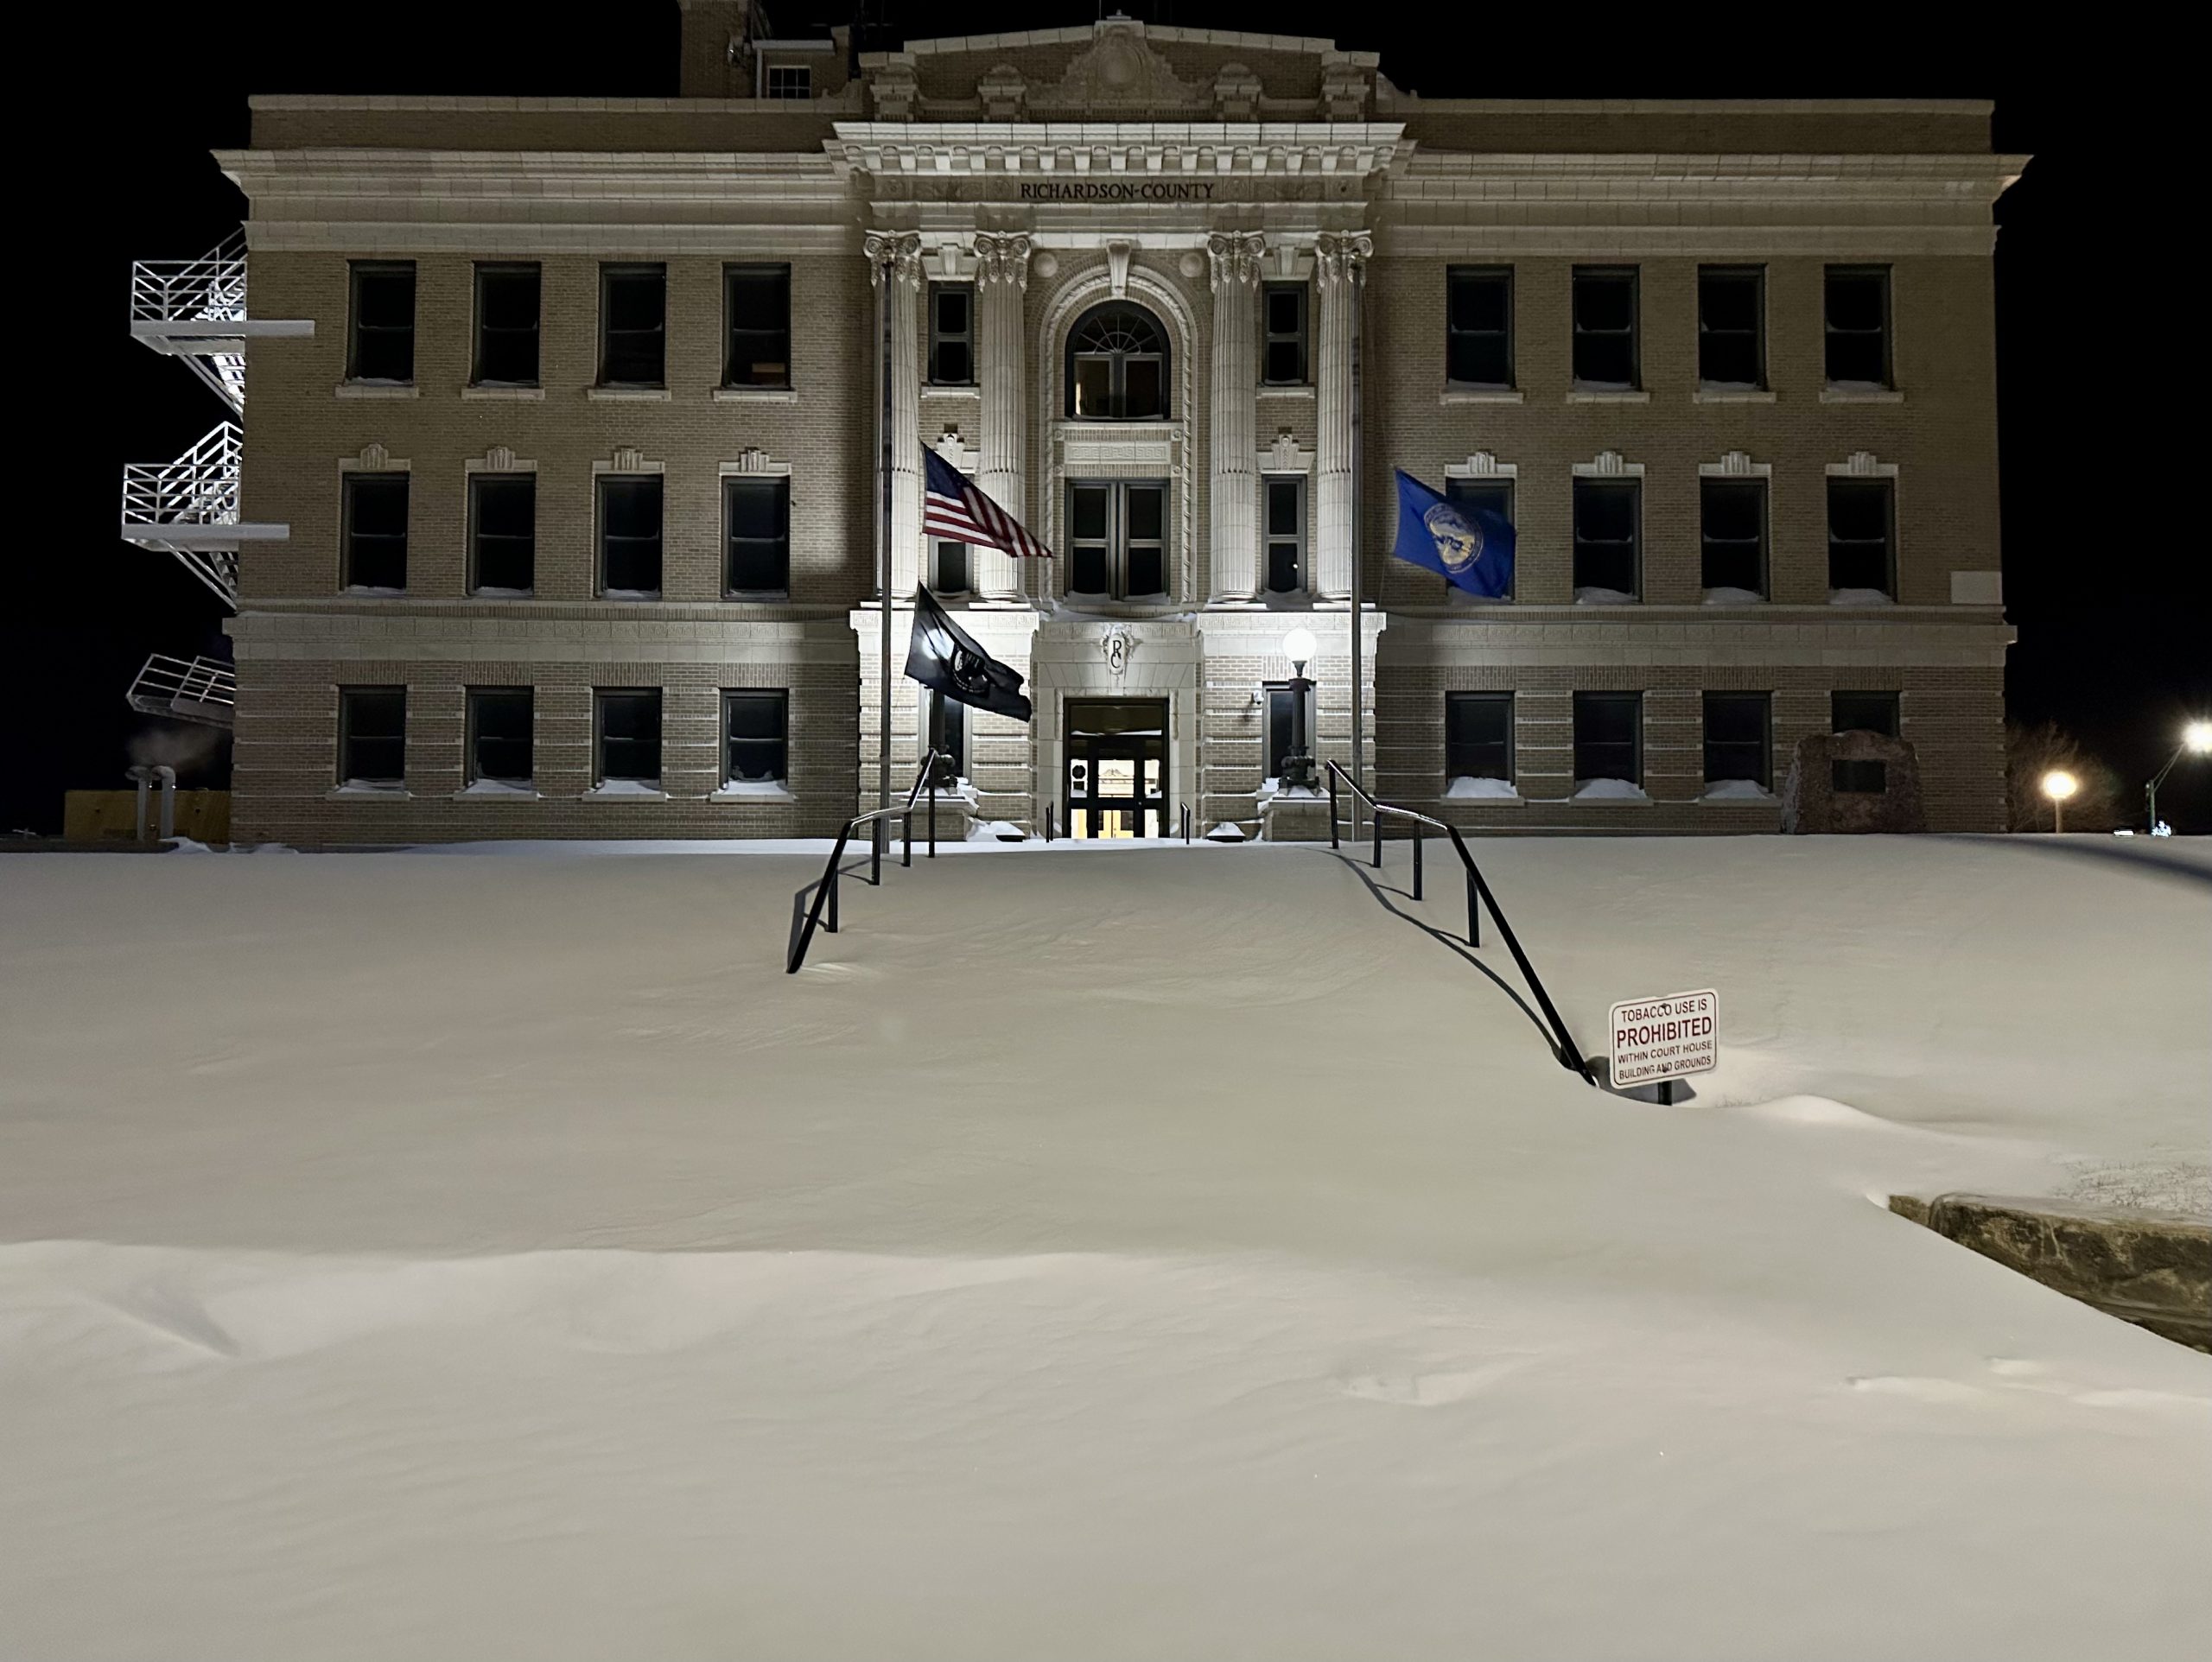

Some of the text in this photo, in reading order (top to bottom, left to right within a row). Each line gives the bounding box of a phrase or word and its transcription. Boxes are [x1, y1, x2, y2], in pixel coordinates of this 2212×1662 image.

[1621, 999, 1707, 1022] TOBACCO USE IS
[1617, 1016, 1712, 1049] PROHIBITED
[1618, 1040, 1713, 1064] WITHIN COURT HOUSE
[1619, 1056, 1711, 1080] BUILDING AND GROUNDS
